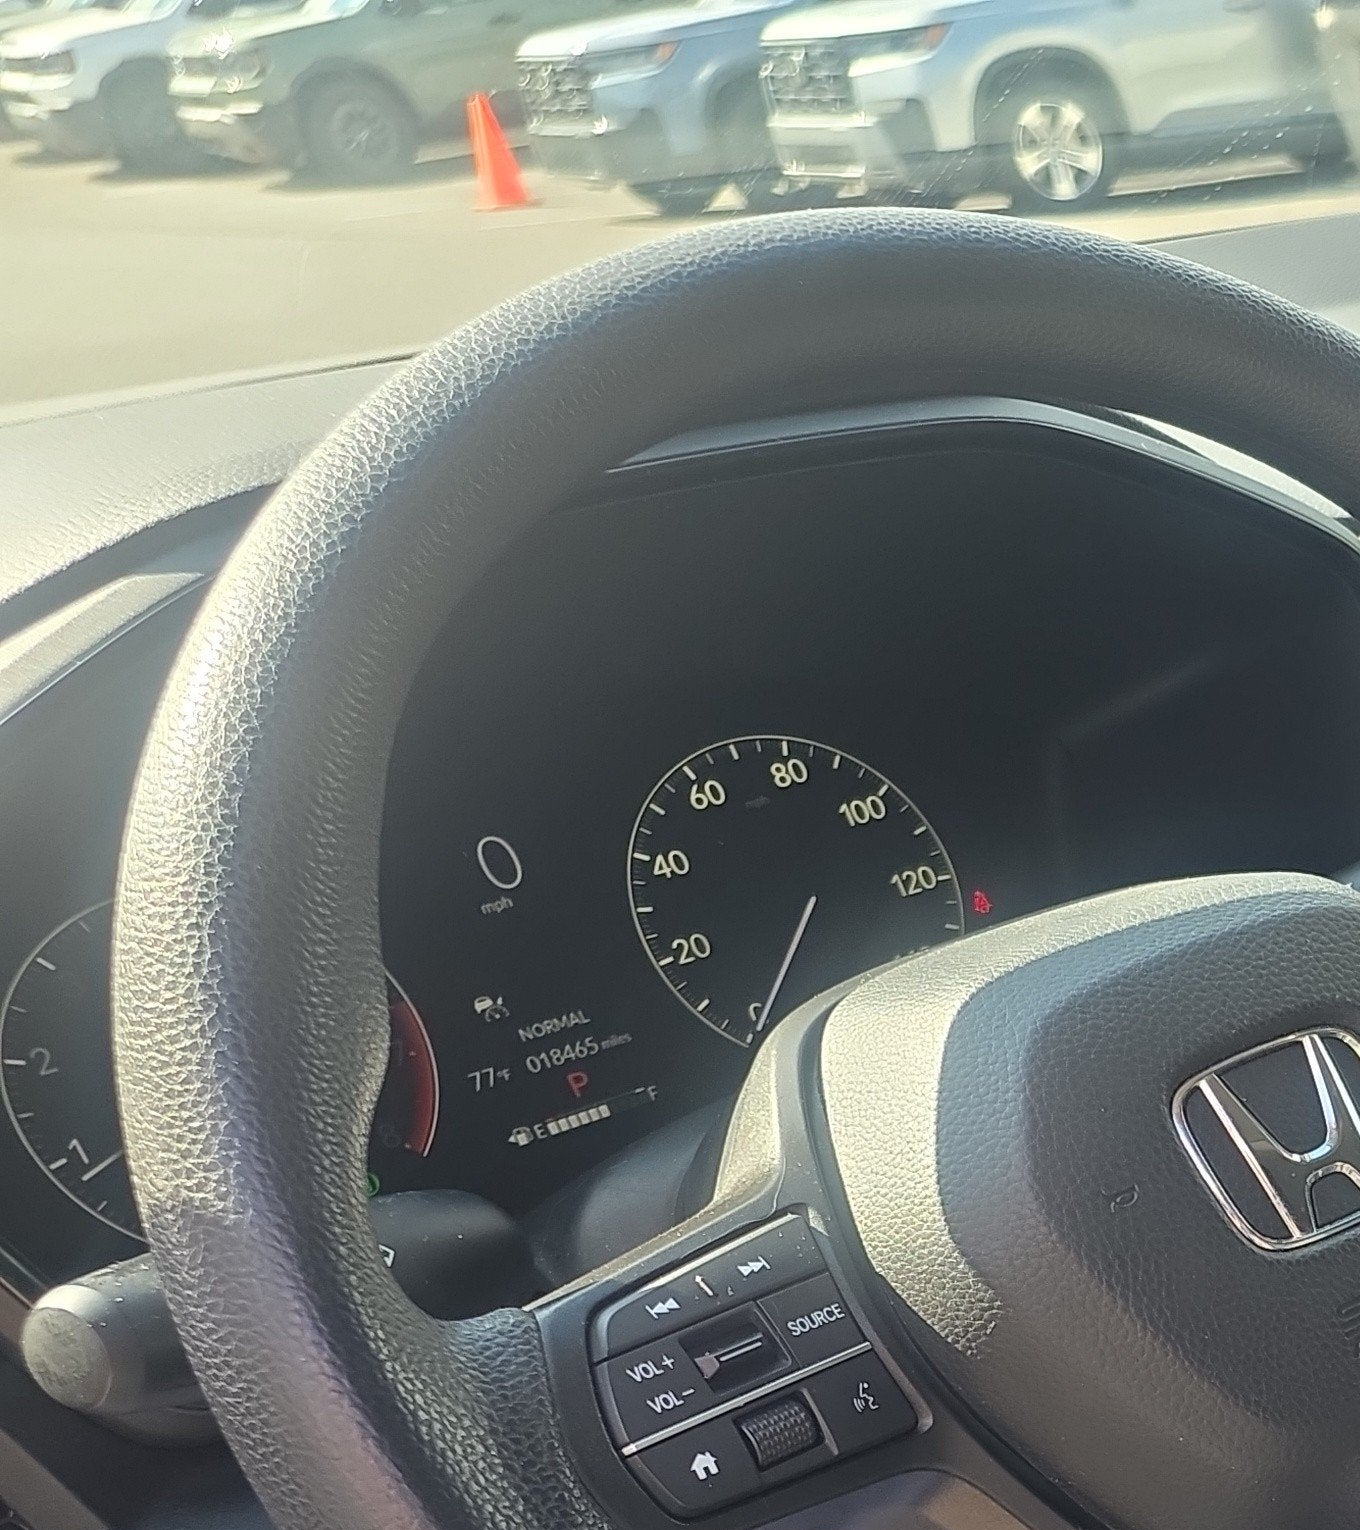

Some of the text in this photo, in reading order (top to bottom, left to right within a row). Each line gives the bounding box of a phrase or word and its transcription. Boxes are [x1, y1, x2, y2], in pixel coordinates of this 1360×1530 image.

[770, 758, 808, 788] 80
[689, 780, 726, 811] 60
[839, 795, 886, 827] 100
[476, 836, 522, 889] 0
[653, 850, 690, 879] 40
[890, 865, 938, 897] 120
[481, 896, 514, 914] mph
[671, 933, 711, 965] 20
[518, 1010, 591, 1042] NORMAL
[29, 1048, 59, 1077] 2
[526, 1033, 633, 1073] 018465 miles
[567, 1071, 588, 1097] P
[647, 1085, 658, 1101] F
[534, 1123, 547, 1139] E
[786, 1303, 846, 1337] SOURCE
[625, 1355, 675, 1383] VOL+
